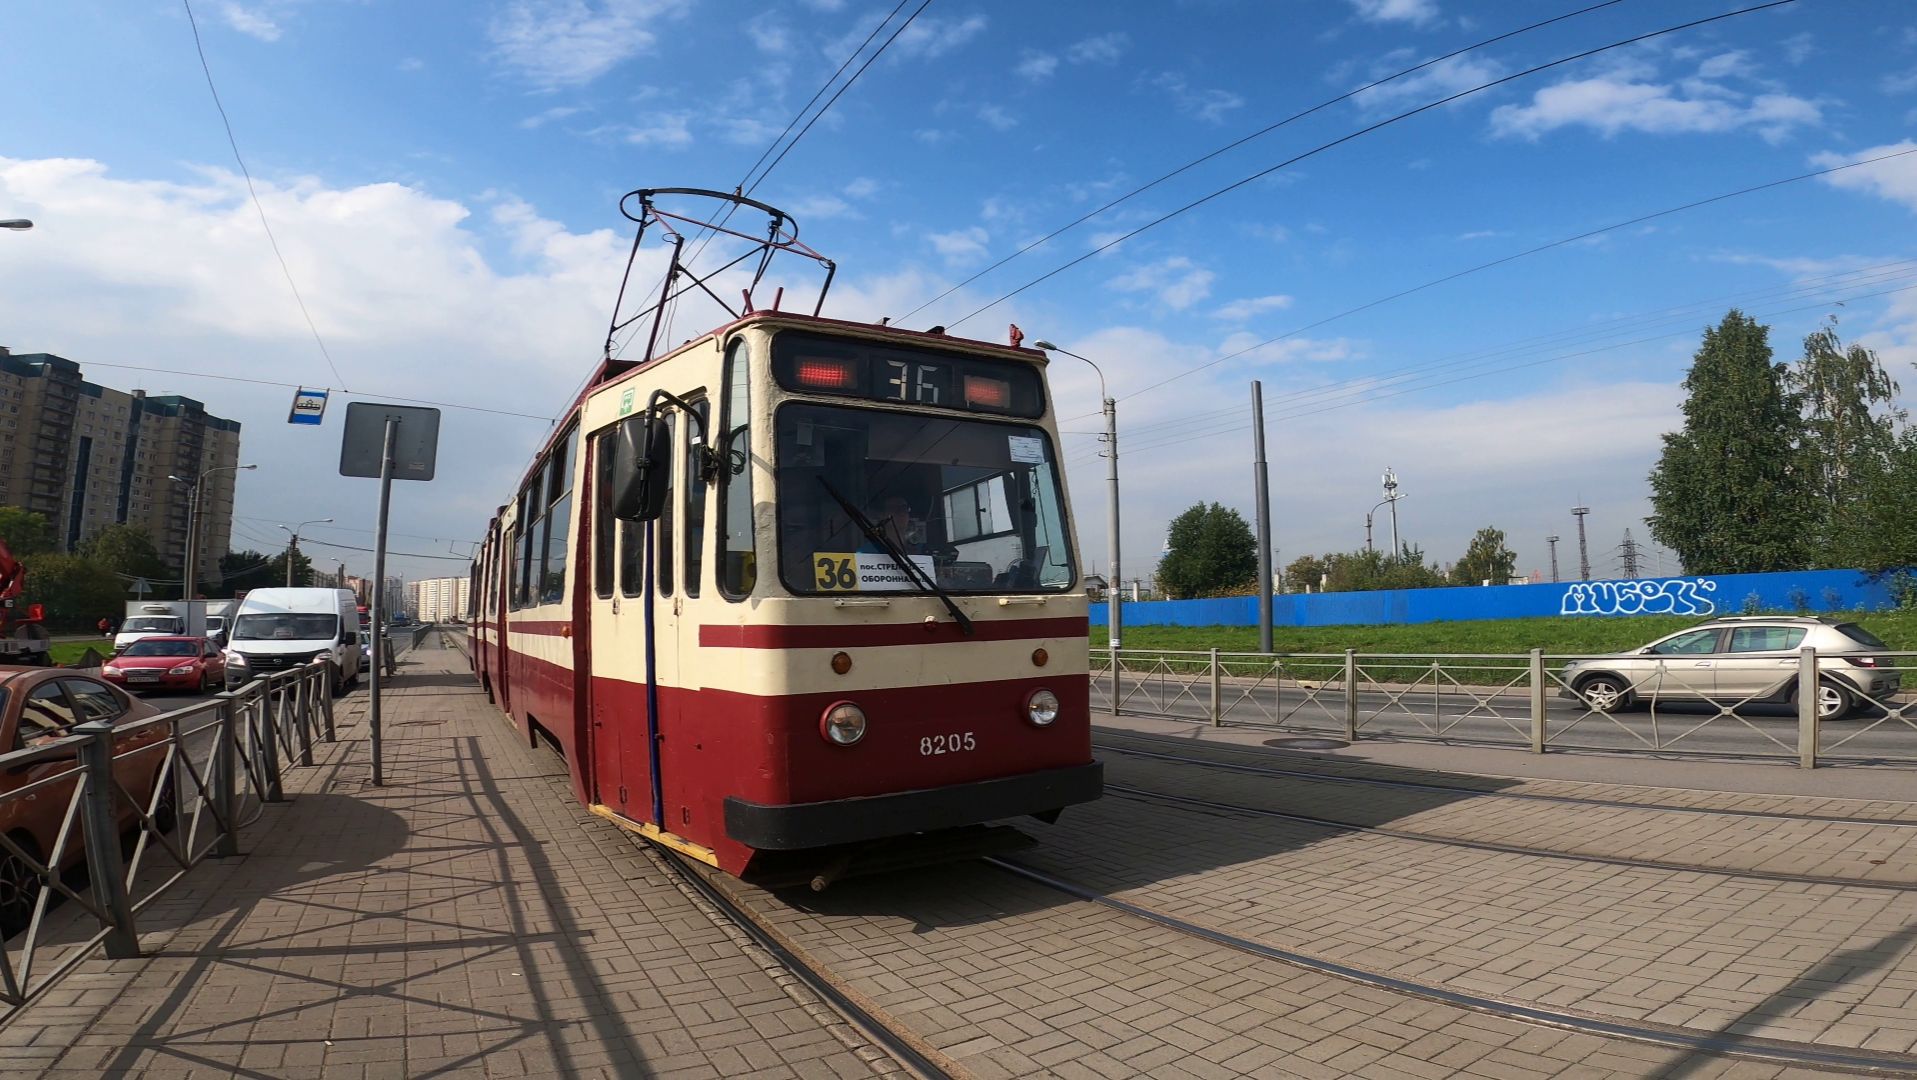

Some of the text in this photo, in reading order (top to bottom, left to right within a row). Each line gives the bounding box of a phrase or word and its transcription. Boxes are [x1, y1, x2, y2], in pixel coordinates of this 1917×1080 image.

[887, 360, 939, 404] 36
[817, 557, 857, 589] 36
[861, 575, 915, 583] ОБОРОННА
[920, 732, 976, 756] 8205
